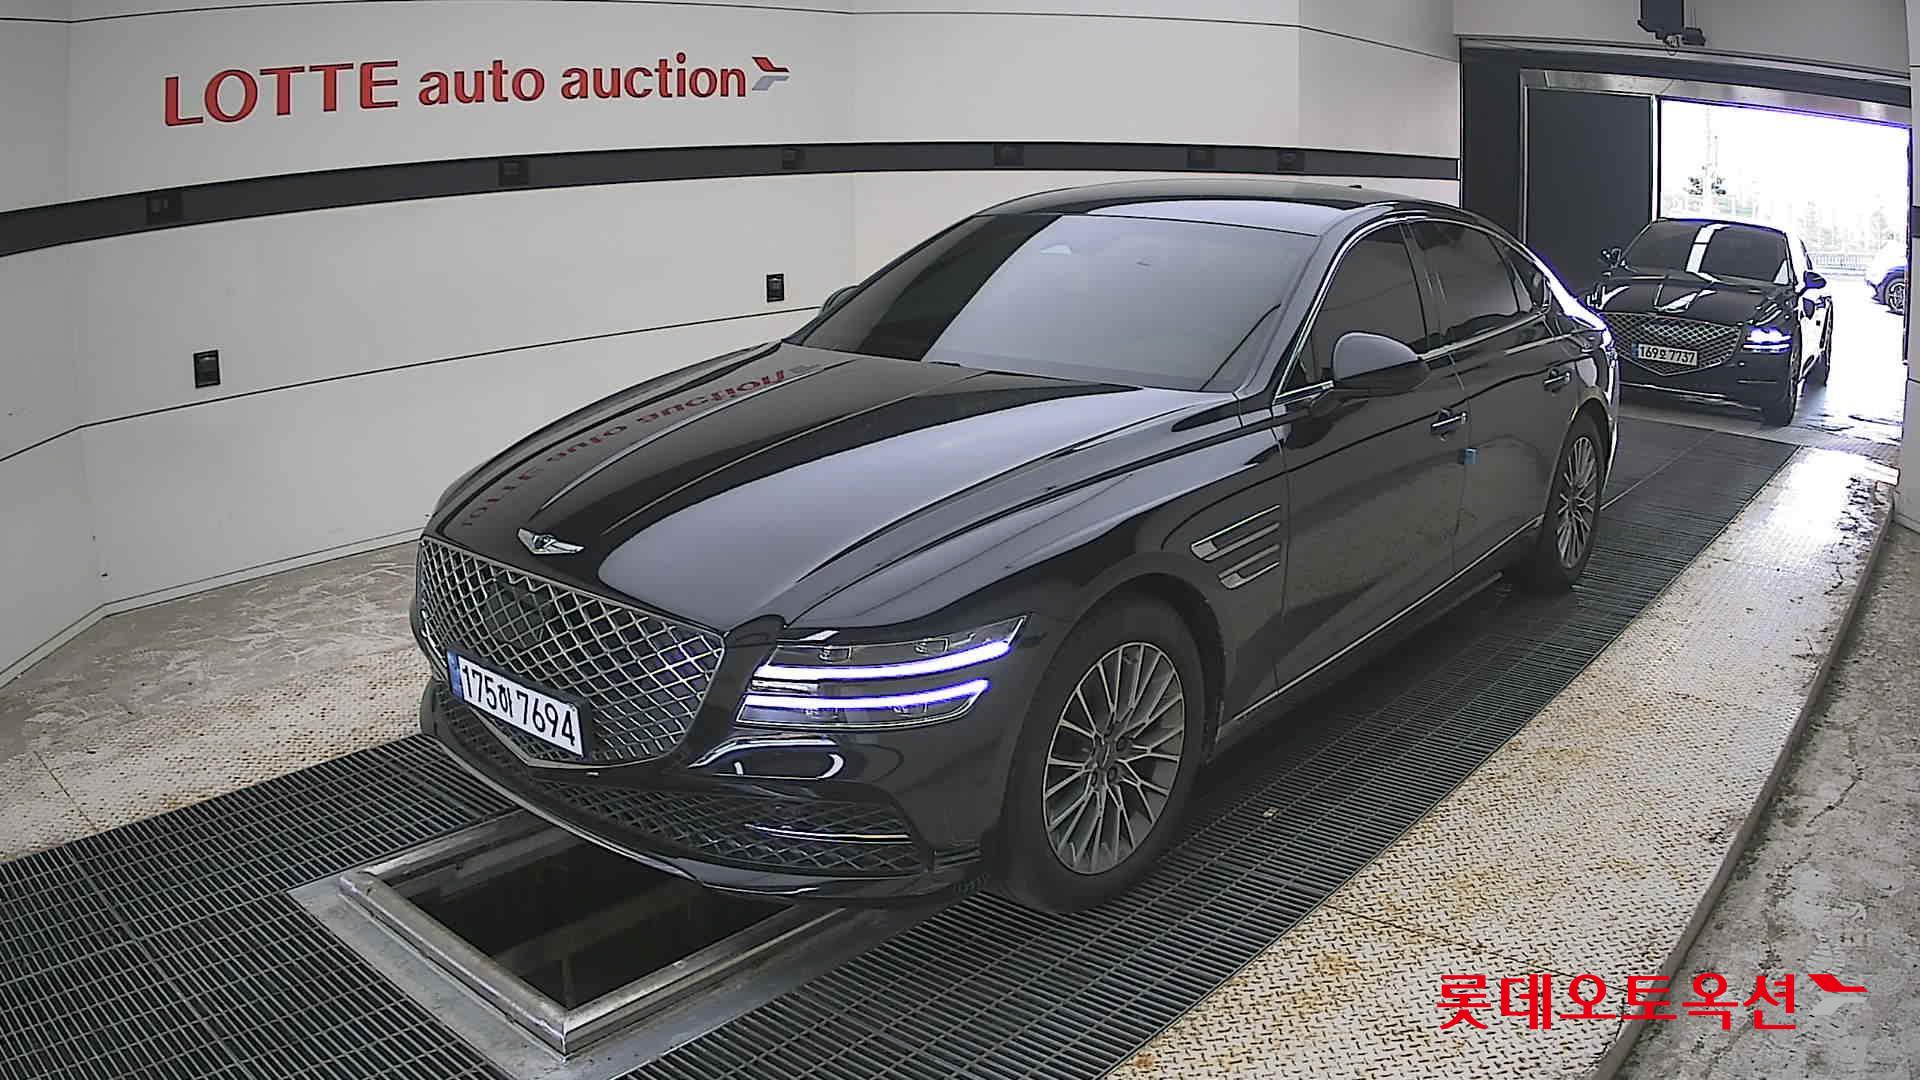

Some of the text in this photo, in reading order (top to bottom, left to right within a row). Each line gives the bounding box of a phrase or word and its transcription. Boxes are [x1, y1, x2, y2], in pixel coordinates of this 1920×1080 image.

[164, 51, 747, 127] LOTTE auto auction
[516, 690, 576, 746] 7694
